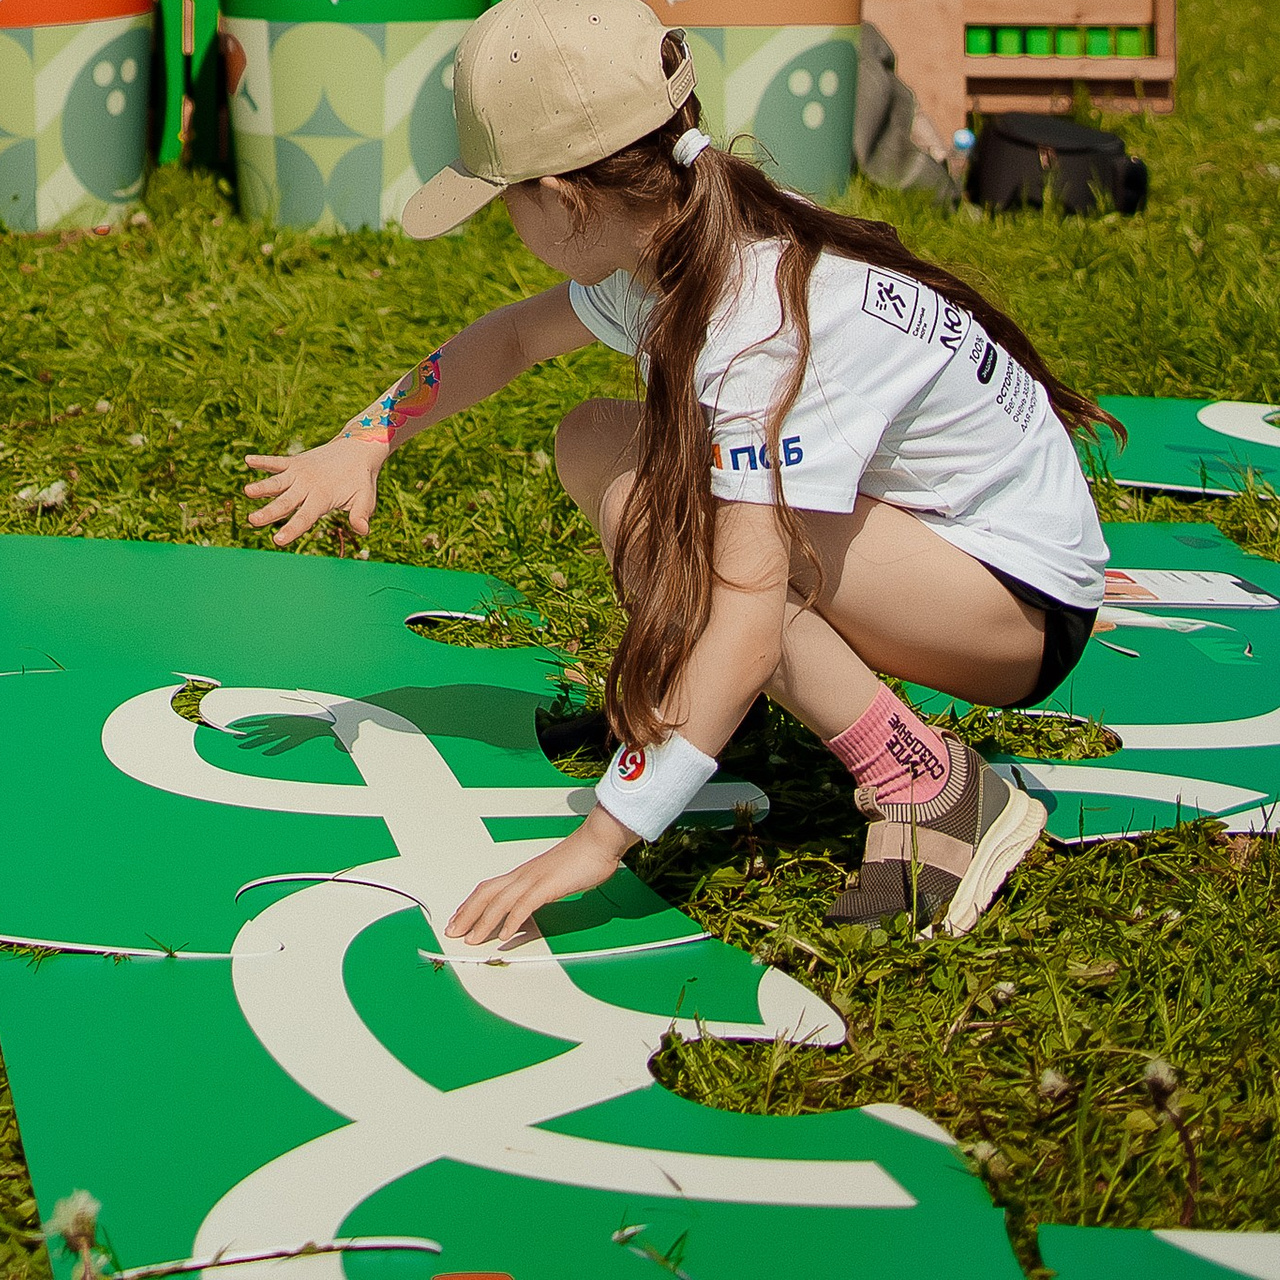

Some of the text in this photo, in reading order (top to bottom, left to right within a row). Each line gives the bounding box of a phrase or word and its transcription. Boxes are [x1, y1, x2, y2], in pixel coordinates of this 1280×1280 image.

[919, 323, 927, 339] ноги
[969, 334, 985, 365] 100%
[1003, 397, 1016, 415] Бег
[1012, 398, 1027, 423] очень
[1020, 413, 1031, 433] для
[729, 435, 804, 471] ПСБ
[887, 712, 945, 780] СОЗДАНИЕ
